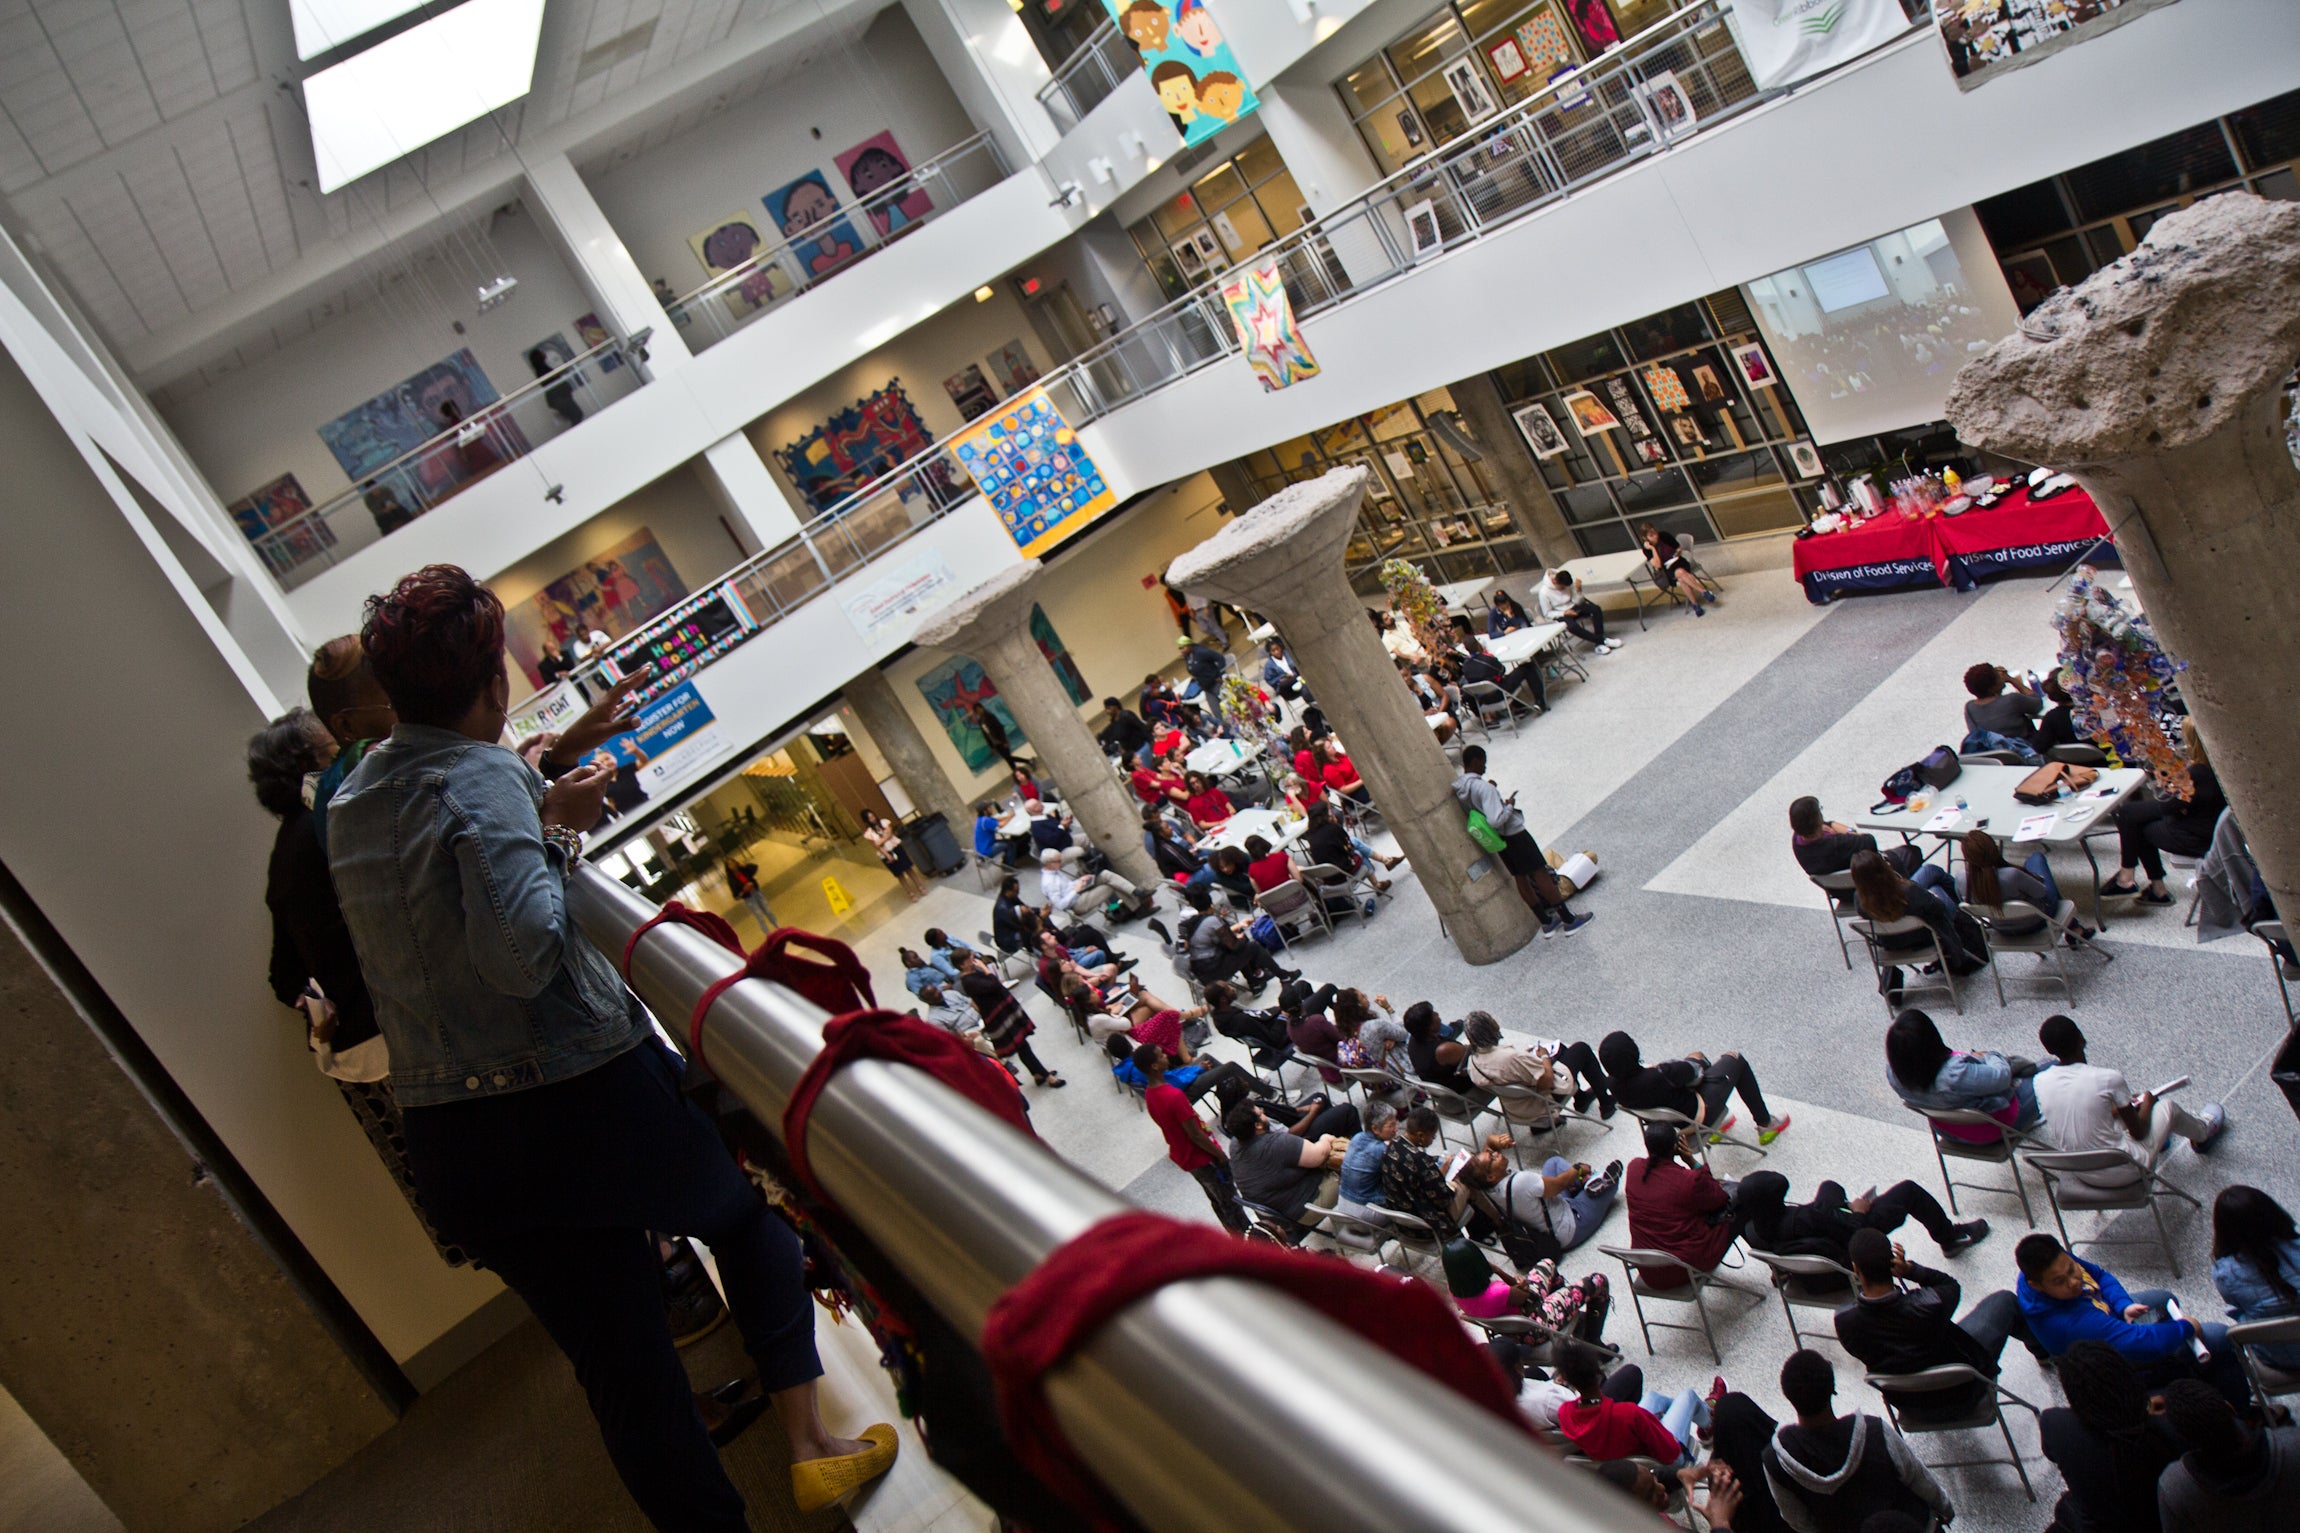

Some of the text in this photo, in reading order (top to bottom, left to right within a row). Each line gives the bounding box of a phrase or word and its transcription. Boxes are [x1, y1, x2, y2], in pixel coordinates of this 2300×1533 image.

[1995, 550, 2008, 563] of
[2009, 546, 2042, 560] Food
[2043, 536, 2097, 556] Services
[1852, 568, 1864, 579] of
[1865, 563, 1893, 577] Food
[1891, 560, 1936, 575] Services
[650, 623, 700, 659] Health
[658, 632, 708, 671] Rocks!
[536, 692, 571, 726] RIGHT
[671, 691, 691, 708] FOR
[635, 698, 701, 743] KINDERGARTEN
[662, 719, 686, 740] NOW
